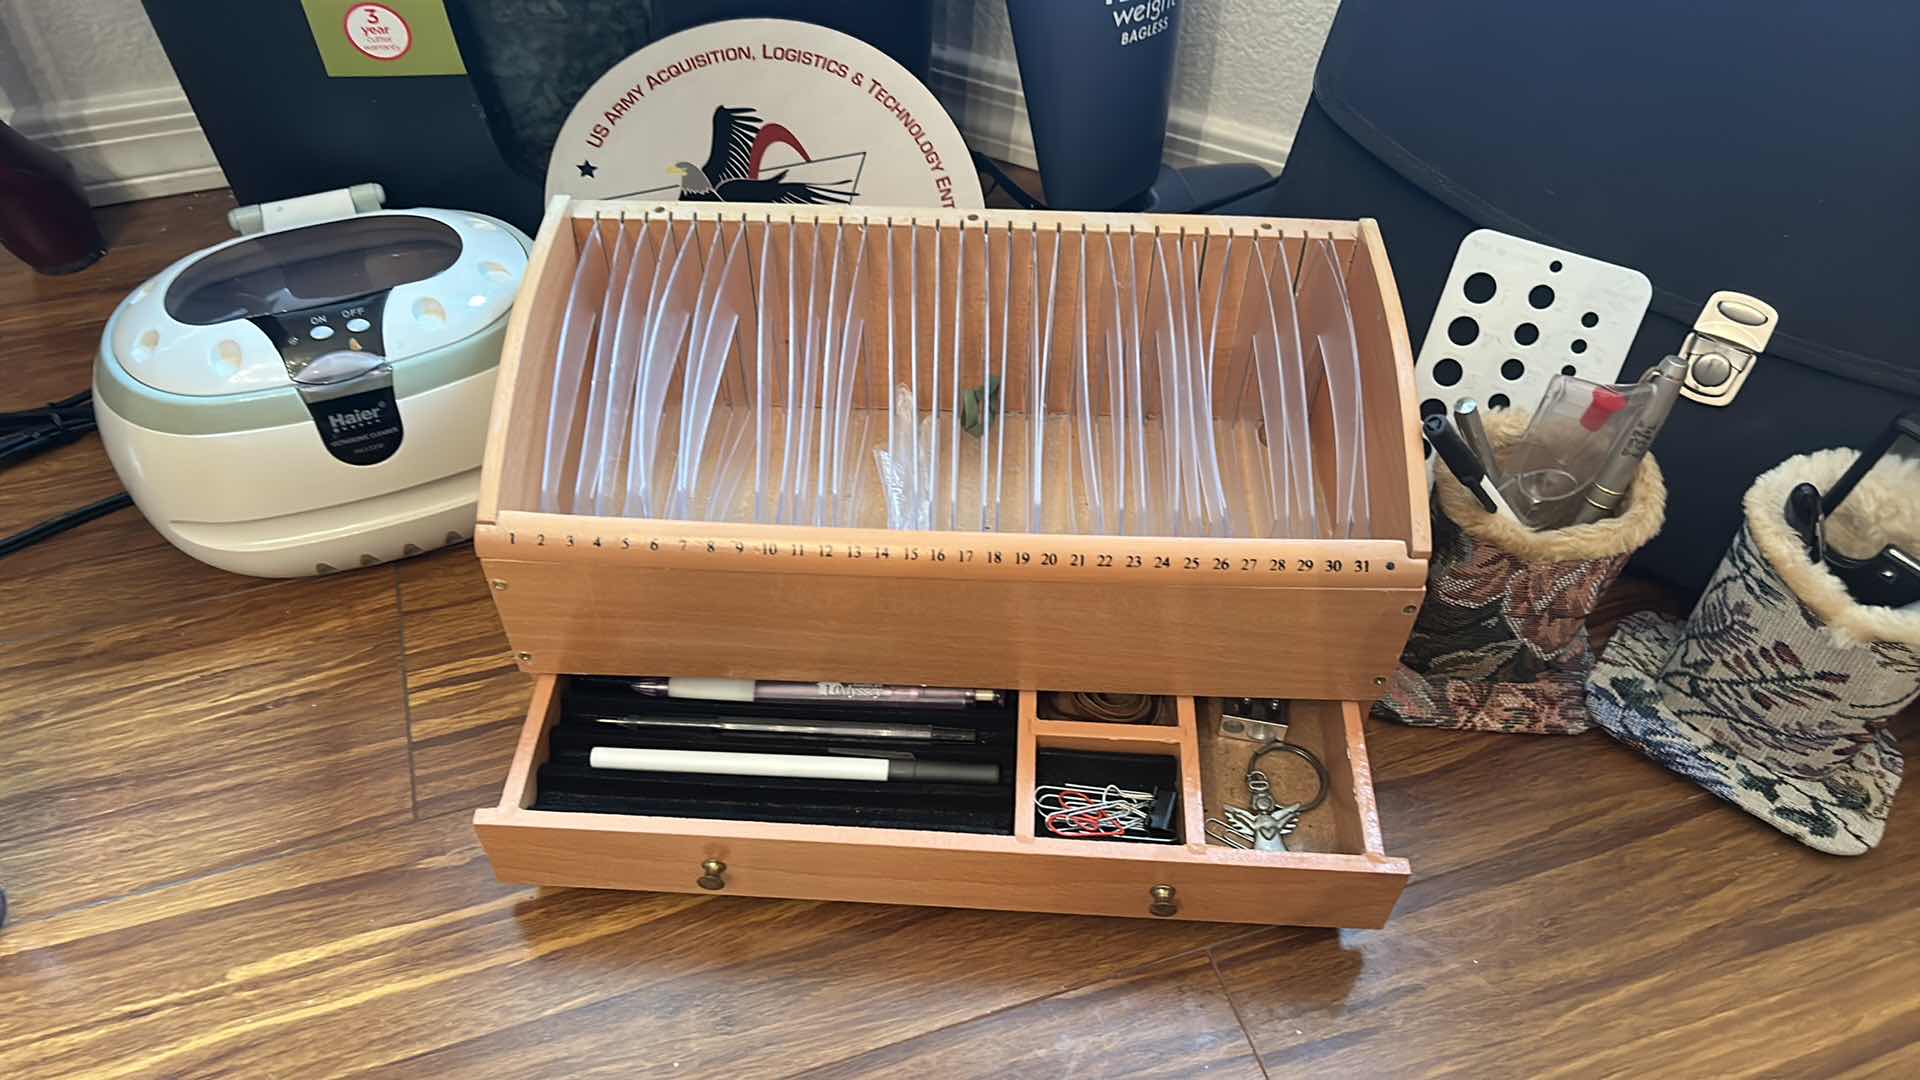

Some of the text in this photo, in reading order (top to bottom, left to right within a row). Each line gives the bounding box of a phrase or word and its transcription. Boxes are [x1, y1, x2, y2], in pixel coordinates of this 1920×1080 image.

[364, 9, 379, 24] 3
[361, 25, 390, 36] year
[1121, 16, 1168, 45] BAGLESS
[586, 123, 610, 148] US
[604, 84, 645, 126] ARMY
[646, 46, 756, 90] ACQUISITION,
[762, 44, 849, 78] LOGISTICS
[851, 72, 865, 87] &
[868, 79, 945, 172] TECHNOLOGY
[310, 315, 328, 325] ON
[341, 307, 365, 319] OFF
[328, 408, 380, 427] Haier
[509, 533, 1370, 572] 1 2 3 4 5 6 7 8 9 10 11 12 13 14 15 16 17 18 19 20 21 22 23 24 25 26 27 28 29 30 31
